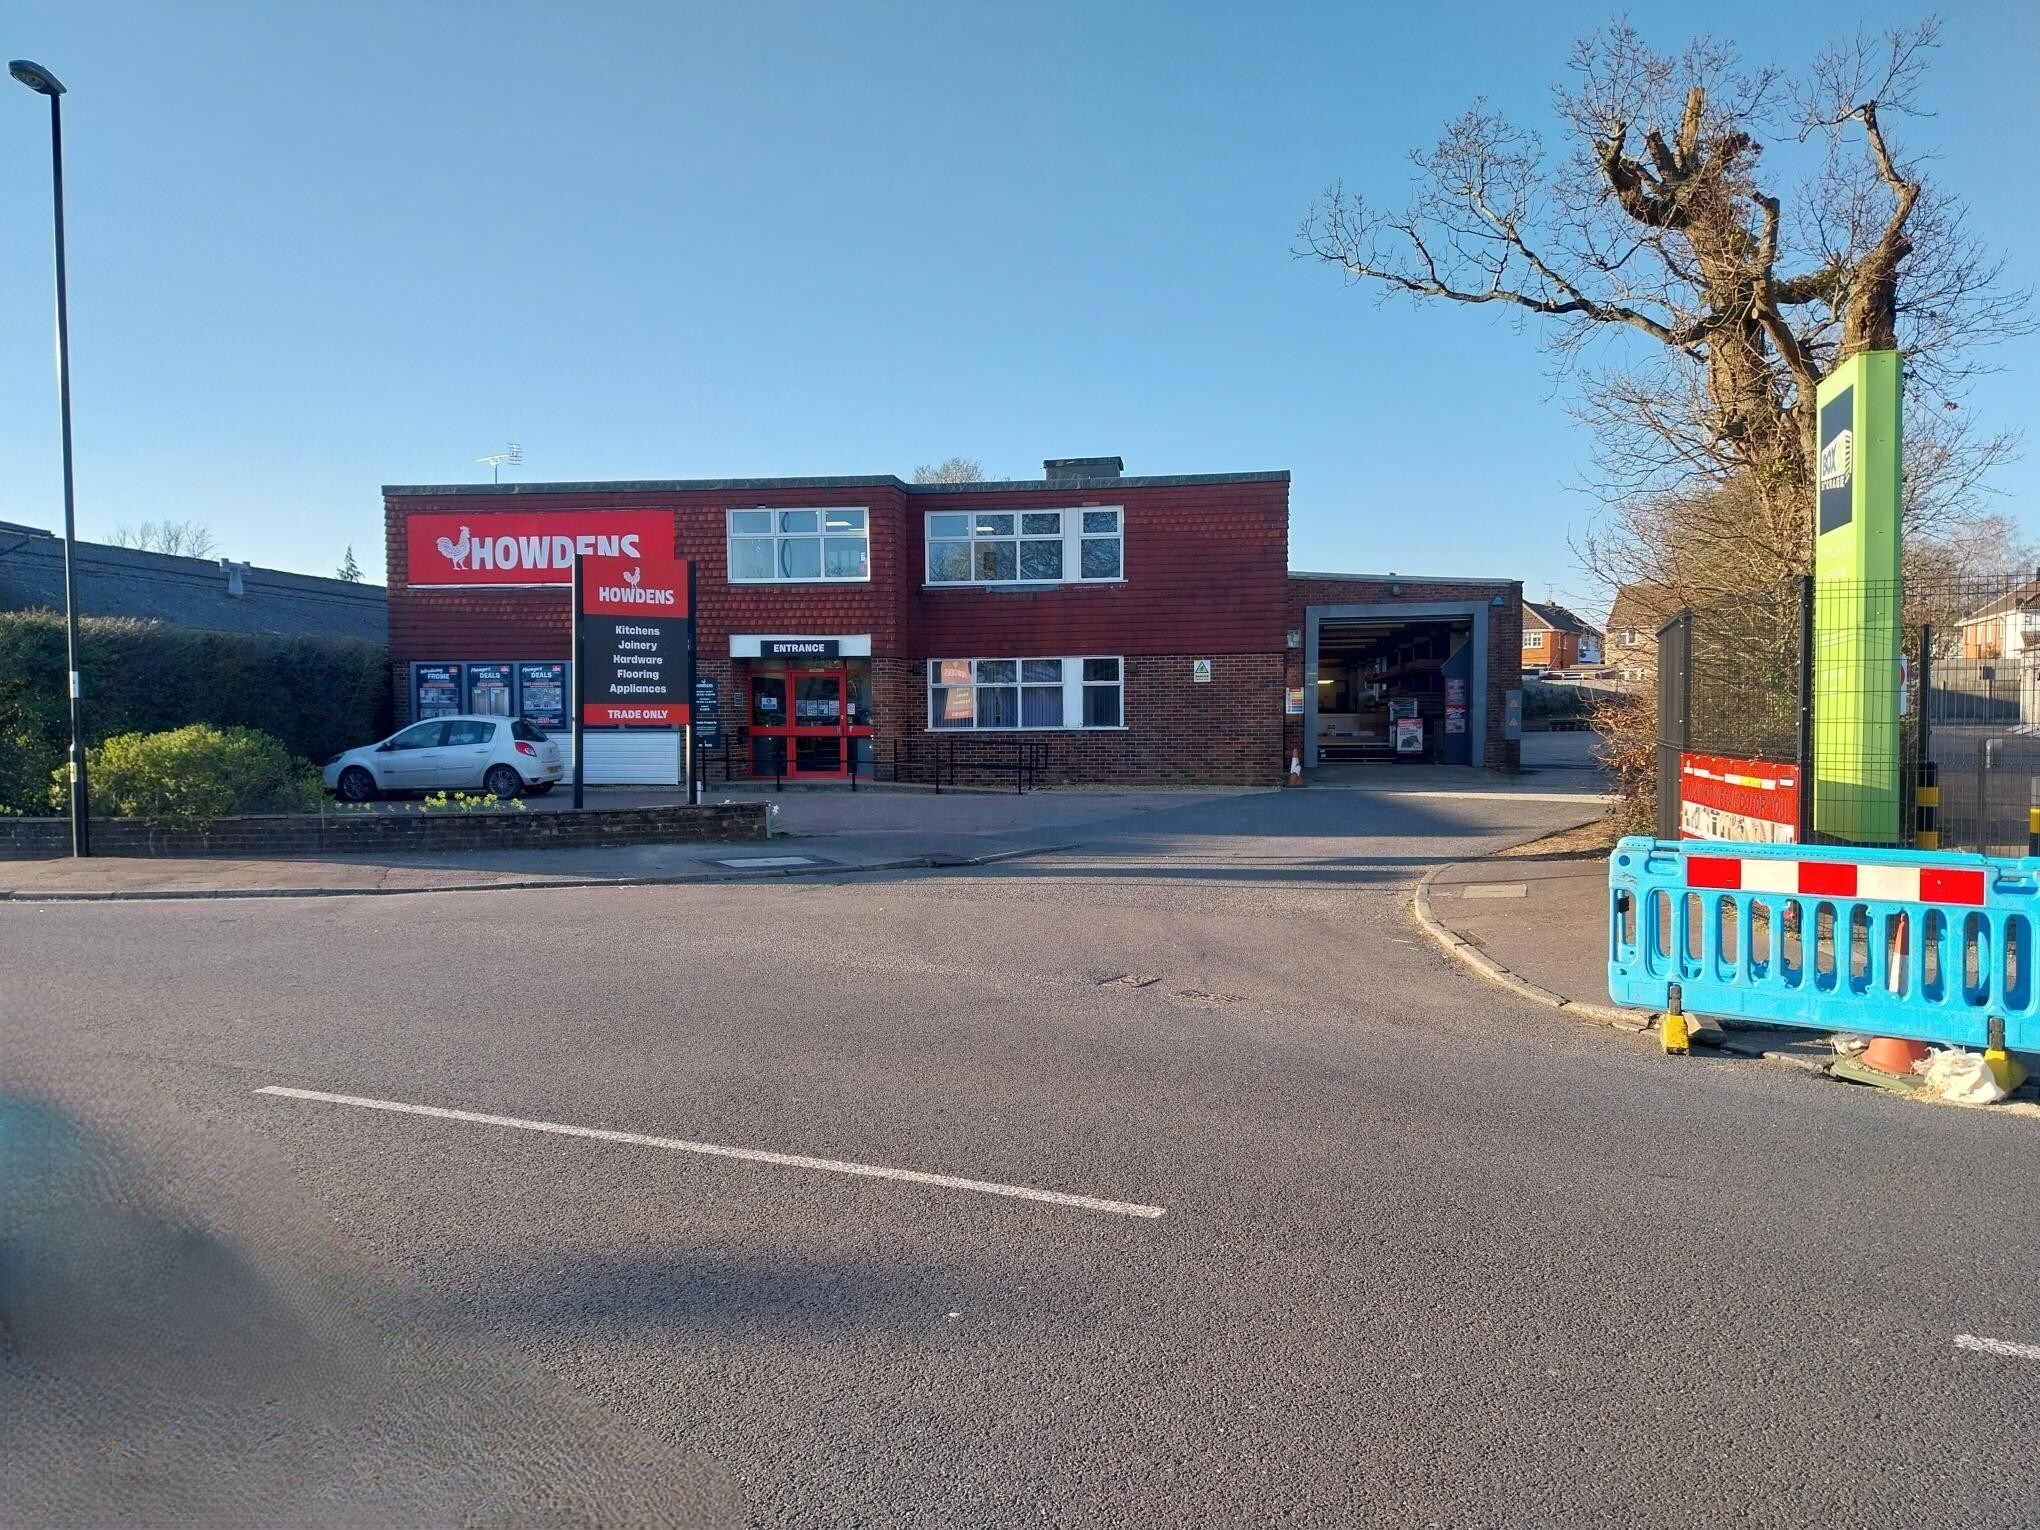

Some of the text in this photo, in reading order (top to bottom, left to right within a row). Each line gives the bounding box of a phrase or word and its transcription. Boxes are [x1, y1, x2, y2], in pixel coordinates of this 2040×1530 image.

[599, 586, 675, 605] HOWDENS
[615, 625, 660, 636] Kitchens
[618, 640, 657, 652] Joinery
[773, 643, 825, 653] ENTRANCE
[613, 655, 663, 665] Hardware
[617, 669, 659, 680] Flooring
[609, 683, 667, 694] Appliances
[608, 710, 668, 719] TRADE ONLY
